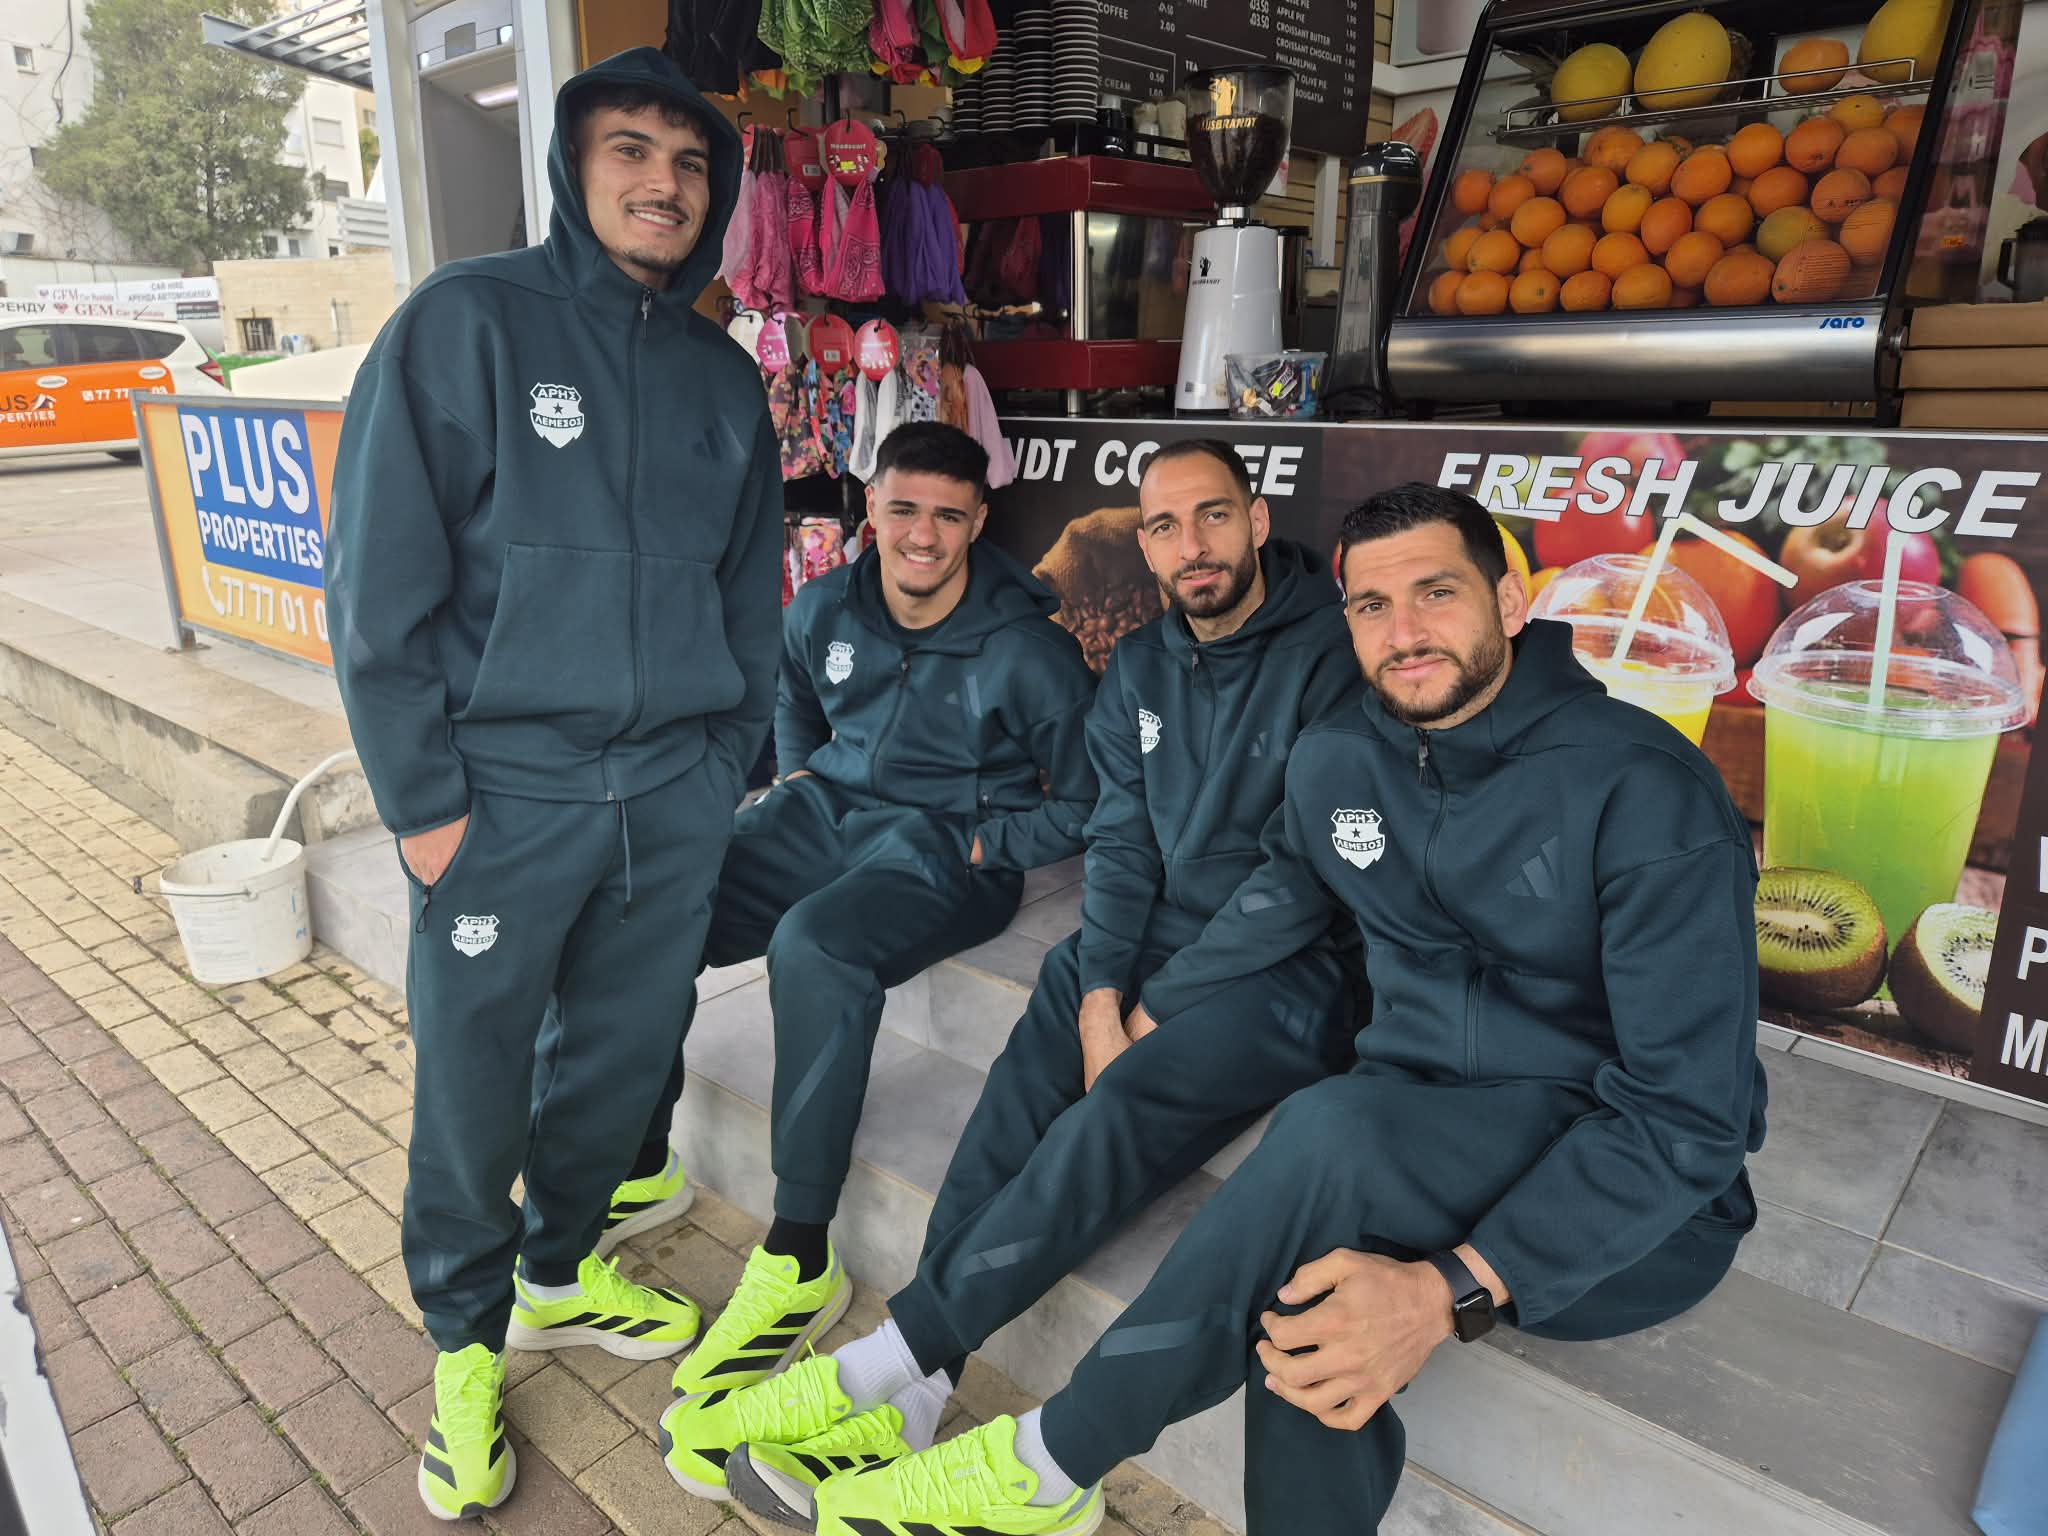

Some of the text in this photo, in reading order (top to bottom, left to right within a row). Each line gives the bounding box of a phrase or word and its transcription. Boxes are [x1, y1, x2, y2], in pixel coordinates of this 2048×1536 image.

[1098, 2, 1128, 20] COFFEE
[1276, 6, 1305, 24] APPLE PIE
[1276, 21, 1331, 46] CROISSANT BUTTER
[1275, 37, 1342, 65] CROISSANT CHOCOLATE
[1275, 52, 1317, 72] PHILADELPHIA
[1185, 60, 1199, 73] TEA
[74, 303, 114, 316] GEM
[1819, 316, 1865, 330] saro
[179, 414, 310, 514] PLUS
[1094, 439, 1304, 497] COEE
[1437, 451, 2042, 538] FRESH JUICE
[198, 510, 324, 570] PROPERTIES
[220, 576, 244, 617] 77
[248, 583, 275, 627] 77
[280, 590, 309, 636] 01
[1337, 813, 1376, 823] ΑΡΗΣ
